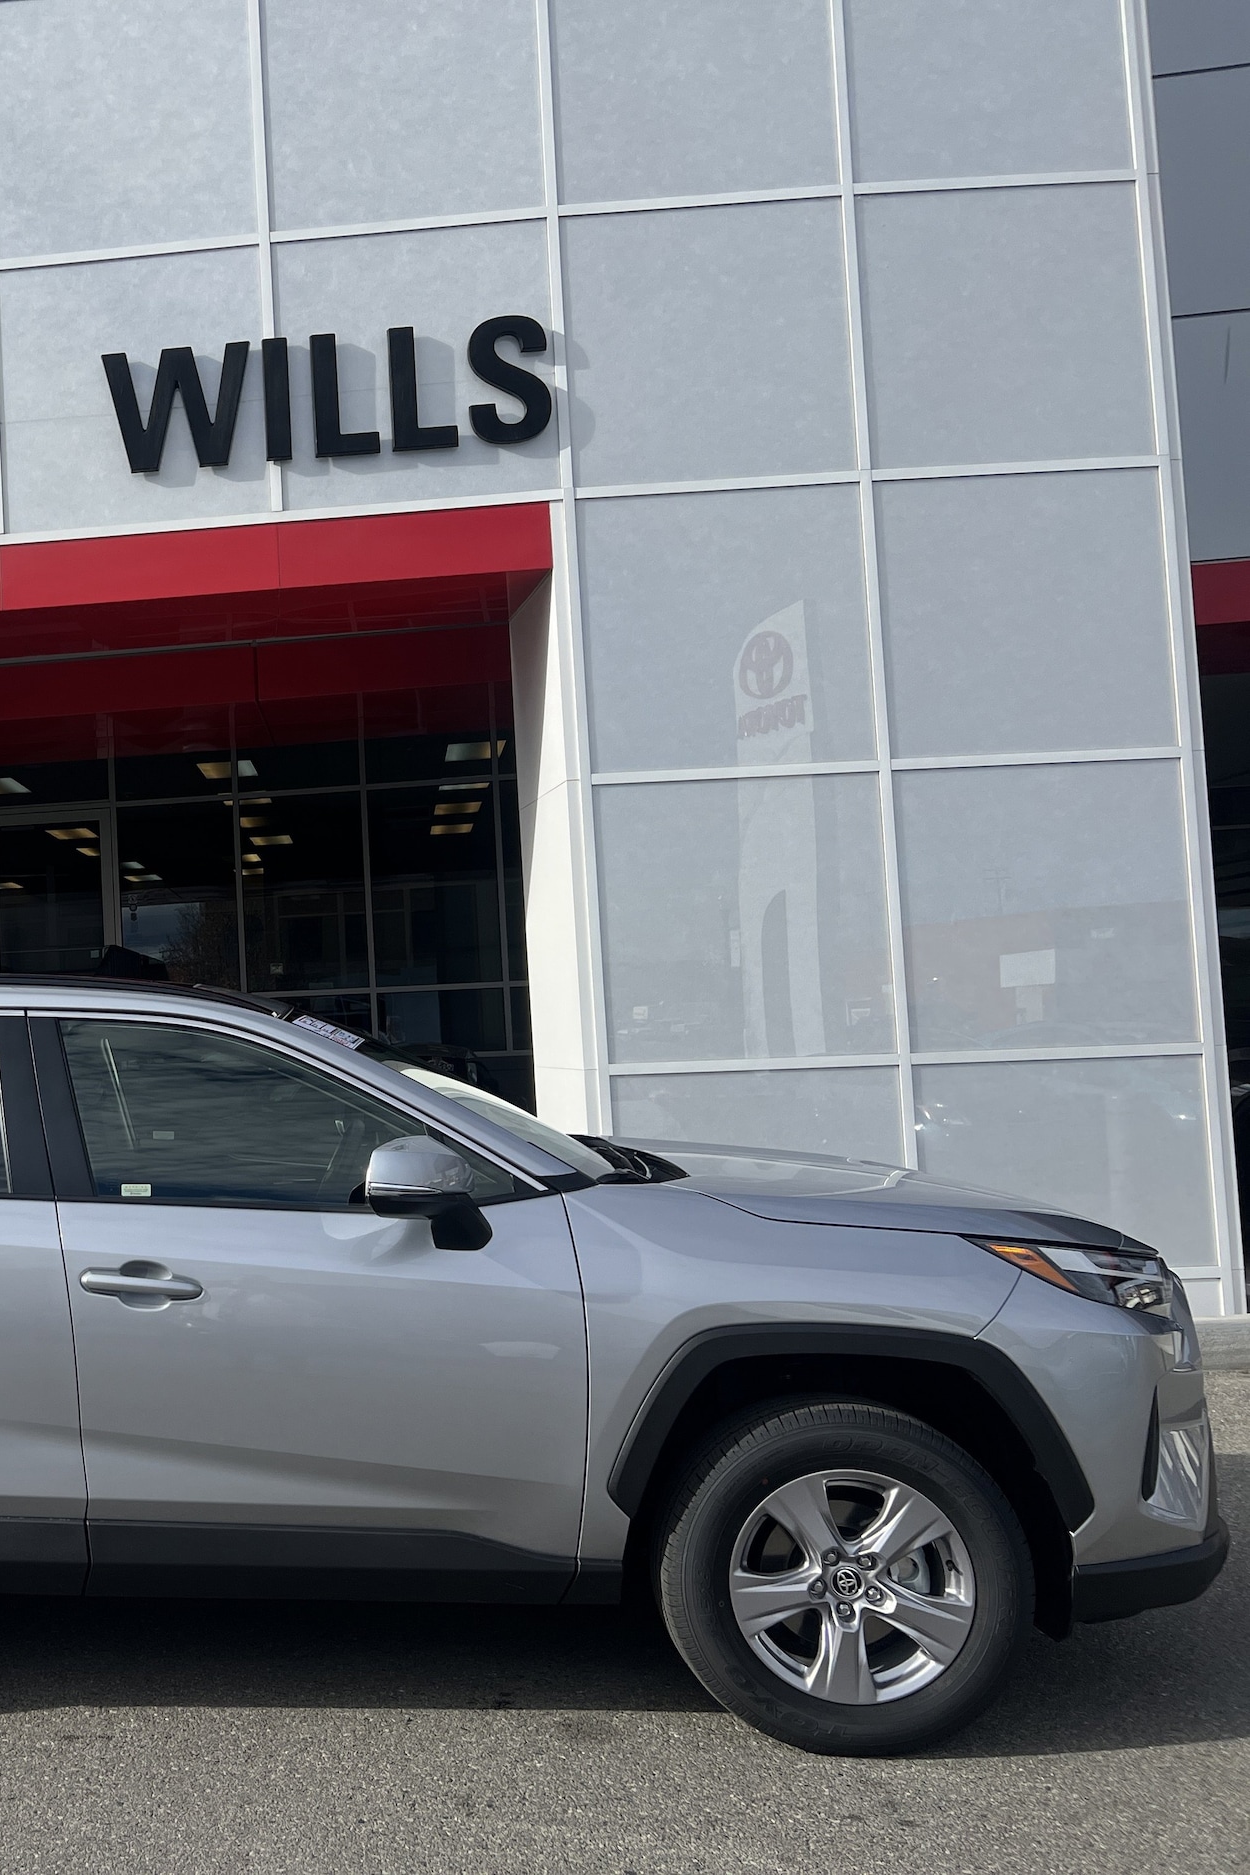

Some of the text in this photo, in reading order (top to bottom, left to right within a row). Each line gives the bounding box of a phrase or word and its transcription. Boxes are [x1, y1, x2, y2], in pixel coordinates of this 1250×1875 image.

[101, 315, 551, 473] WILLS
[821, 1435, 940, 1472] OPEN
[720, 1663, 850, 1740] TOYO
